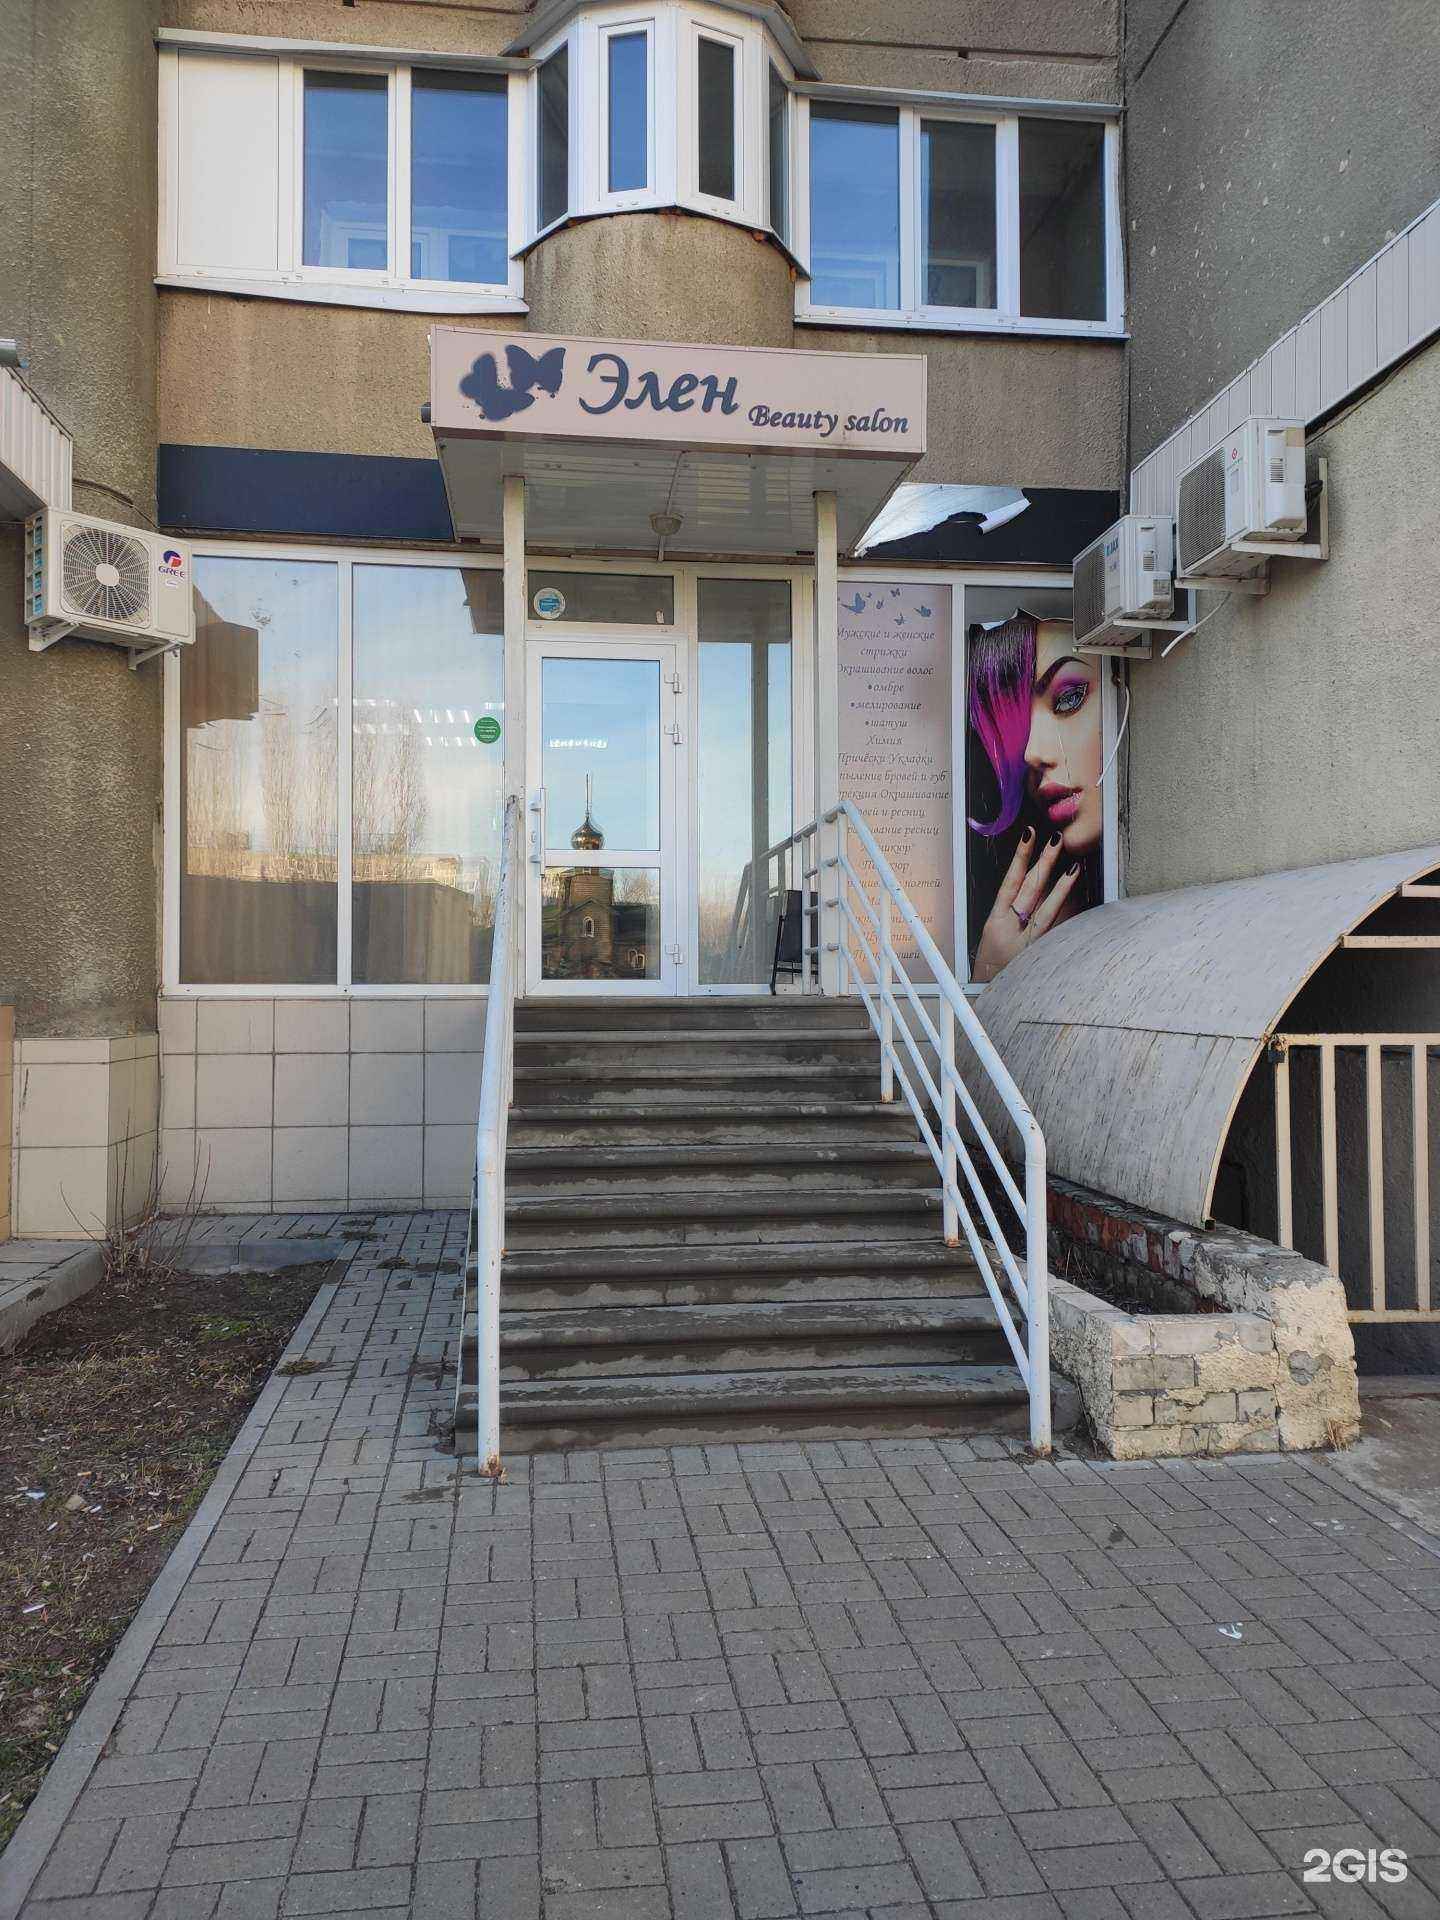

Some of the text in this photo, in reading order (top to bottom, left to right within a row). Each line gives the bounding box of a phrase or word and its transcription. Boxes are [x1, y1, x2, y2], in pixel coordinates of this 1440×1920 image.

[578, 352, 740, 416] Элен
[747, 404, 909, 438] Beauty salon
[158, 565, 185, 578] GREE
[892, 631, 936, 642] женские
